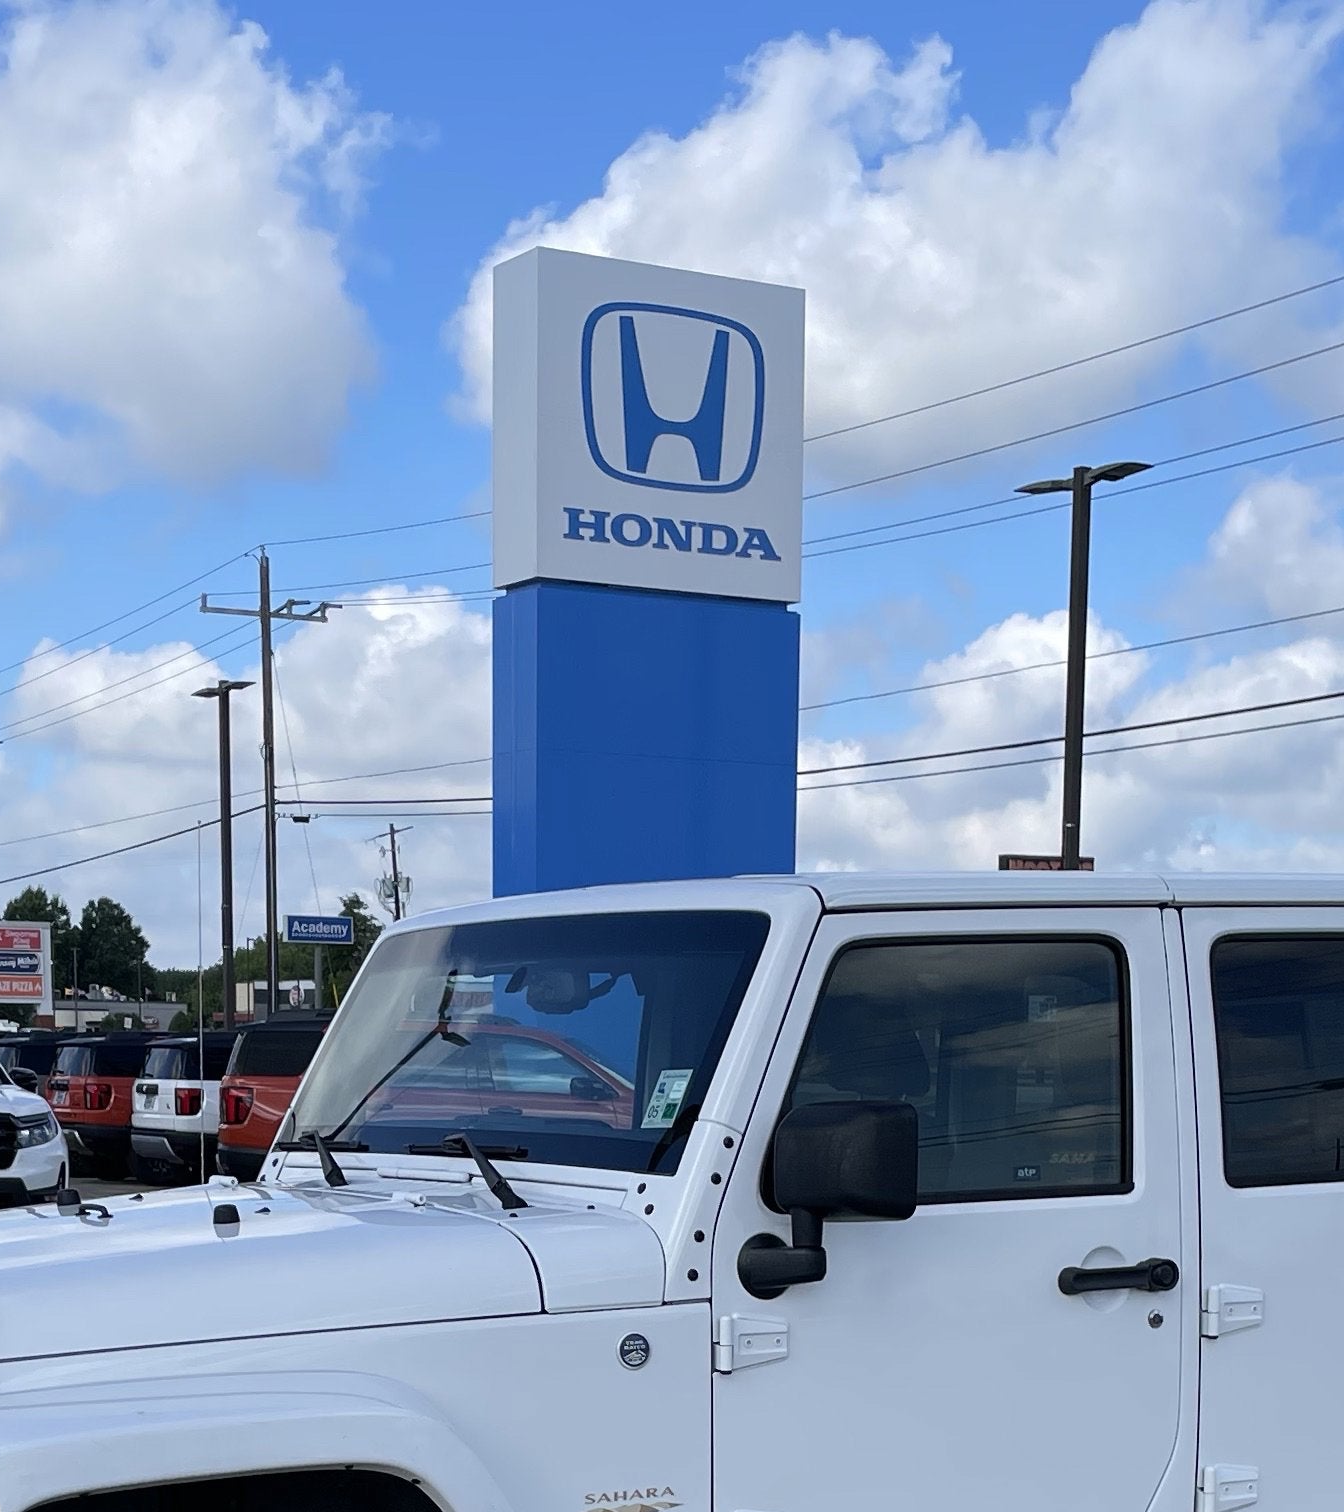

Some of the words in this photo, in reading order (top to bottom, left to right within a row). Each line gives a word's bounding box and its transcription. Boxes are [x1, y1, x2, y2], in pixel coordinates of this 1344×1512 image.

[563, 506, 782, 562] HONDA
[292, 921, 348, 937] Academy
[584, 1486, 675, 1505] SAHARA
